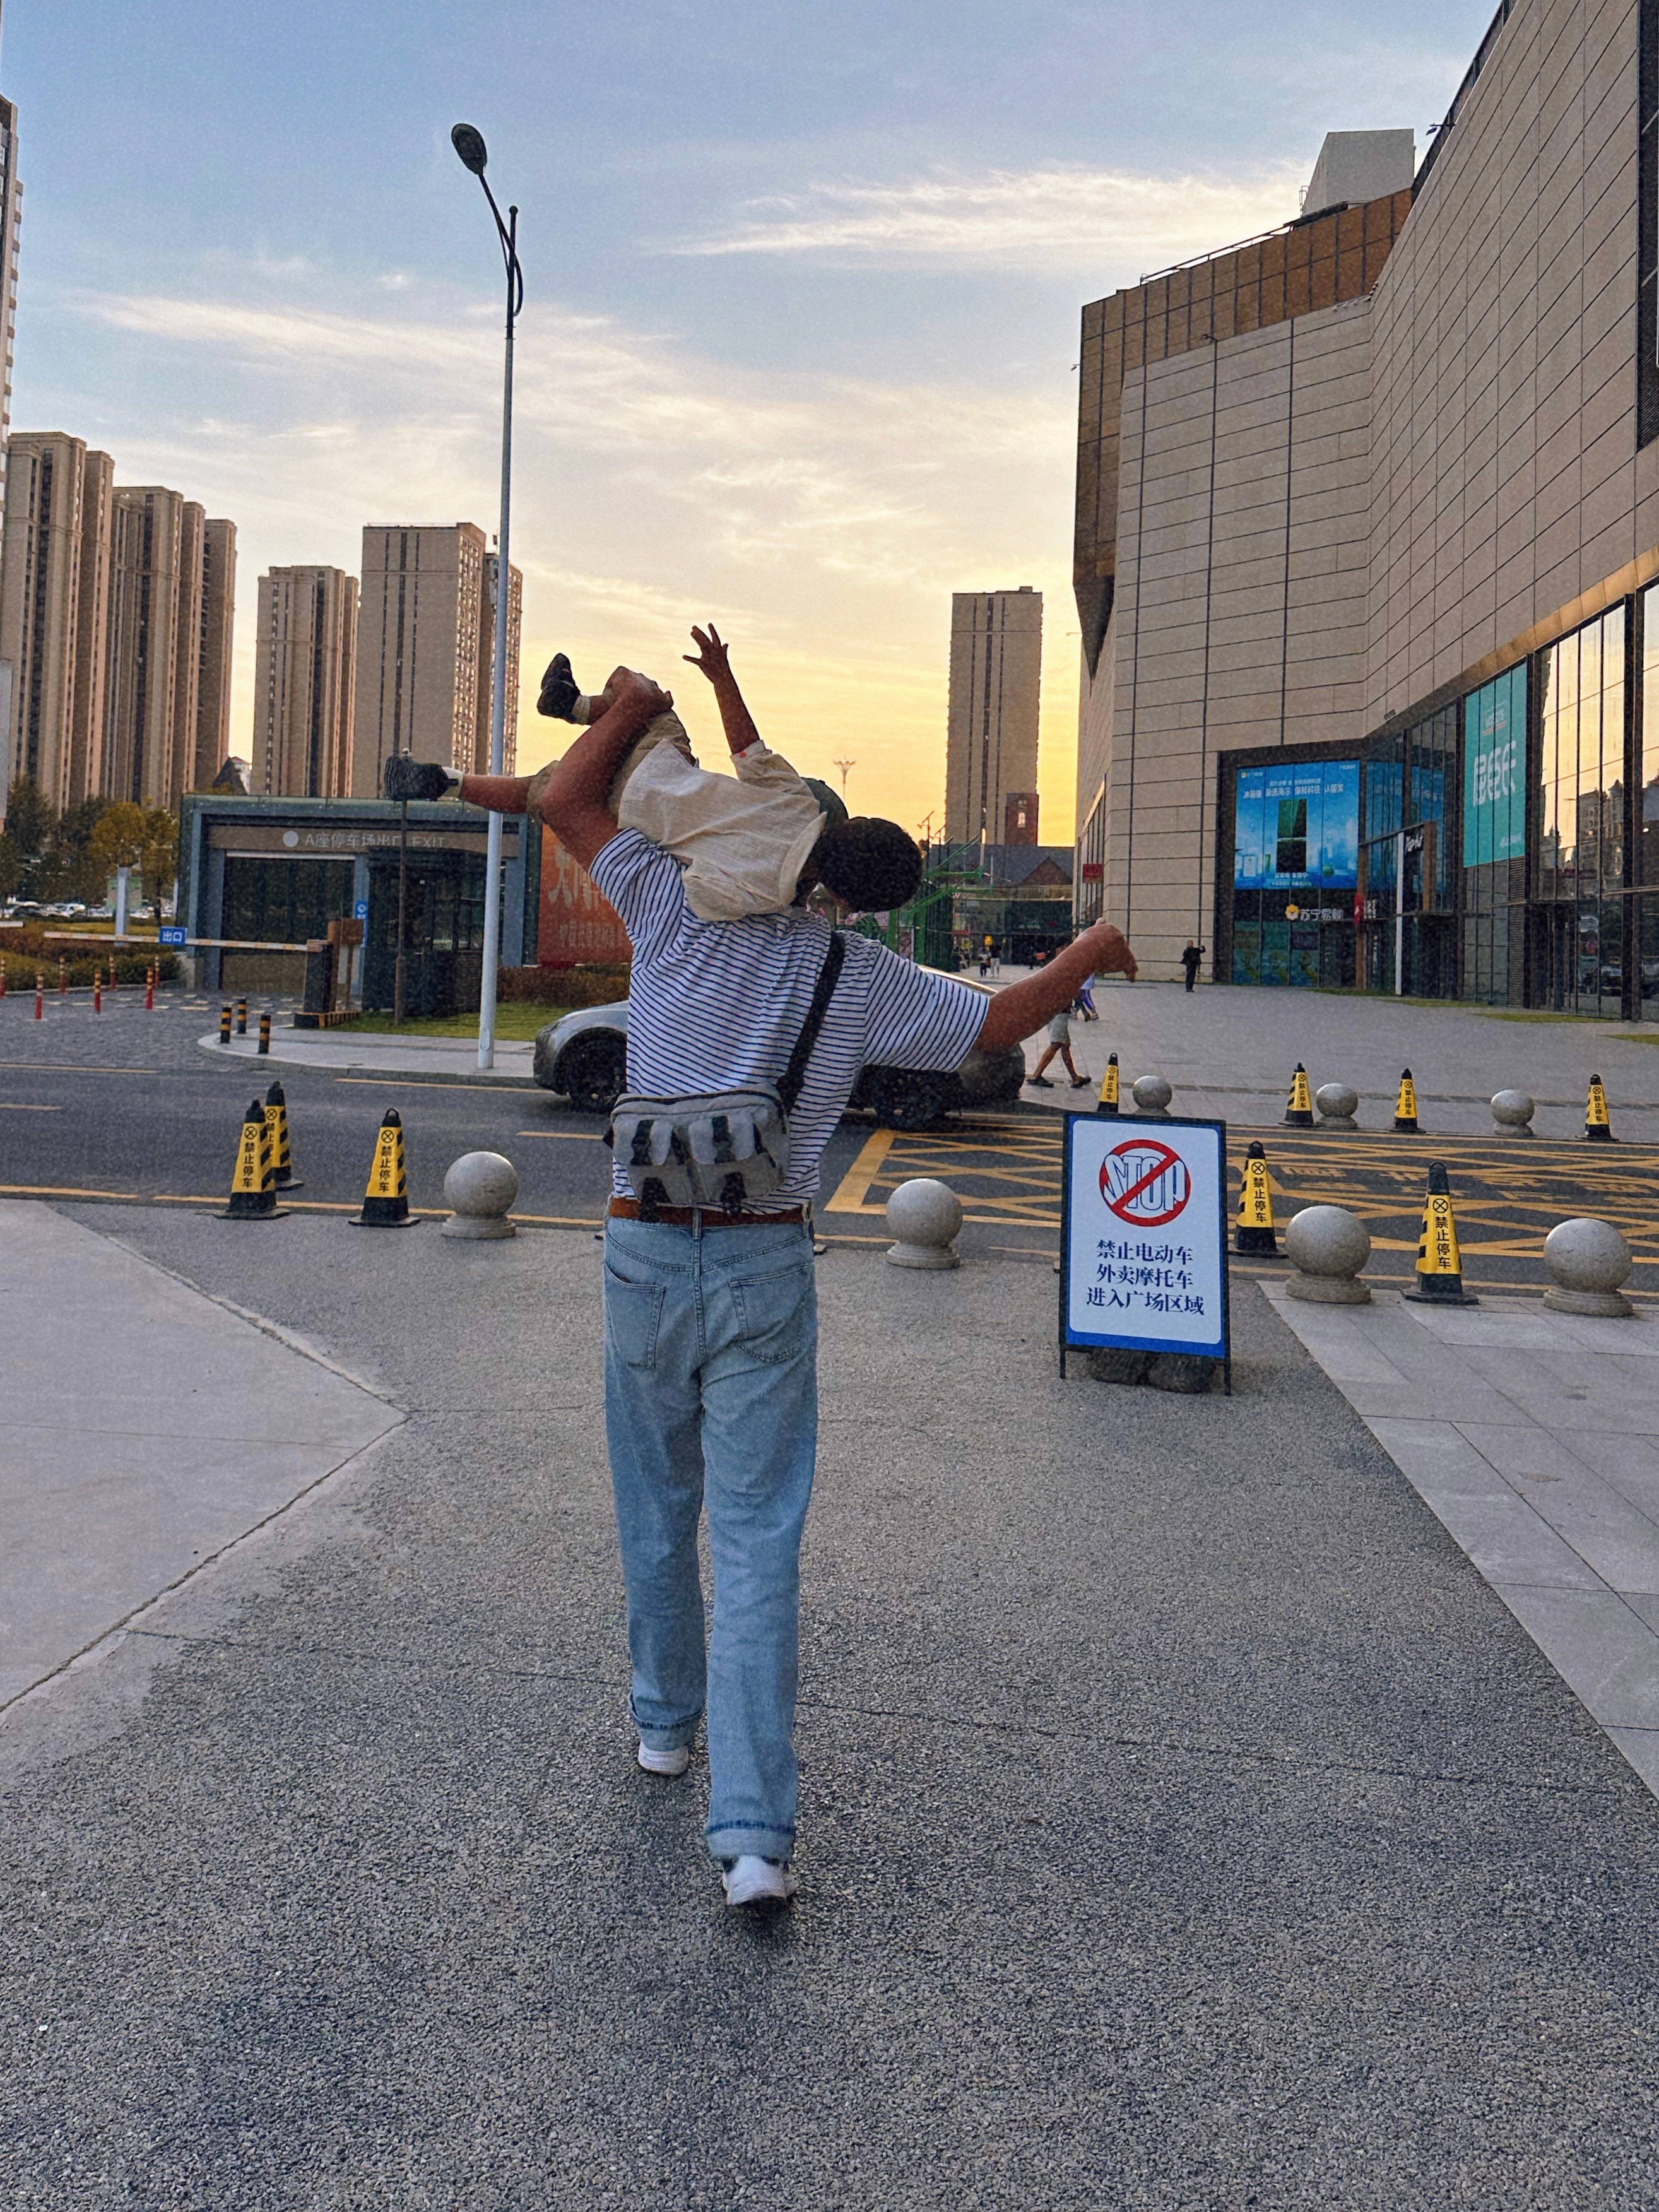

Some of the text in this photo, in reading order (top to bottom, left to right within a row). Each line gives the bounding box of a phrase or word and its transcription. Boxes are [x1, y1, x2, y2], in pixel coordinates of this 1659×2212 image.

[412, 836, 446, 848] EXIT
[1300, 908, 1344, 921] 苏宁易购
[162, 930, 183, 942] 出口
[1106, 1075, 1114, 1100] 禁止停车
[1299, 1082, 1307, 1108] 禁止停车
[1594, 1095, 1603, 1122] 禁止停车
[242, 1142, 256, 1188] 禁止停车
[379, 1145, 392, 1193] 禁止停车
[1103, 1153, 1186, 1212] STOP
[1253, 1176, 1267, 1223] 禁止停车
[1096, 1239, 1193, 1265] 禁止电动车
[1434, 1215, 1451, 1269] 禁止停车
[1095, 1263, 1194, 1289] 外卖摩托车
[1085, 1287, 1205, 1316] 进入广场区域
